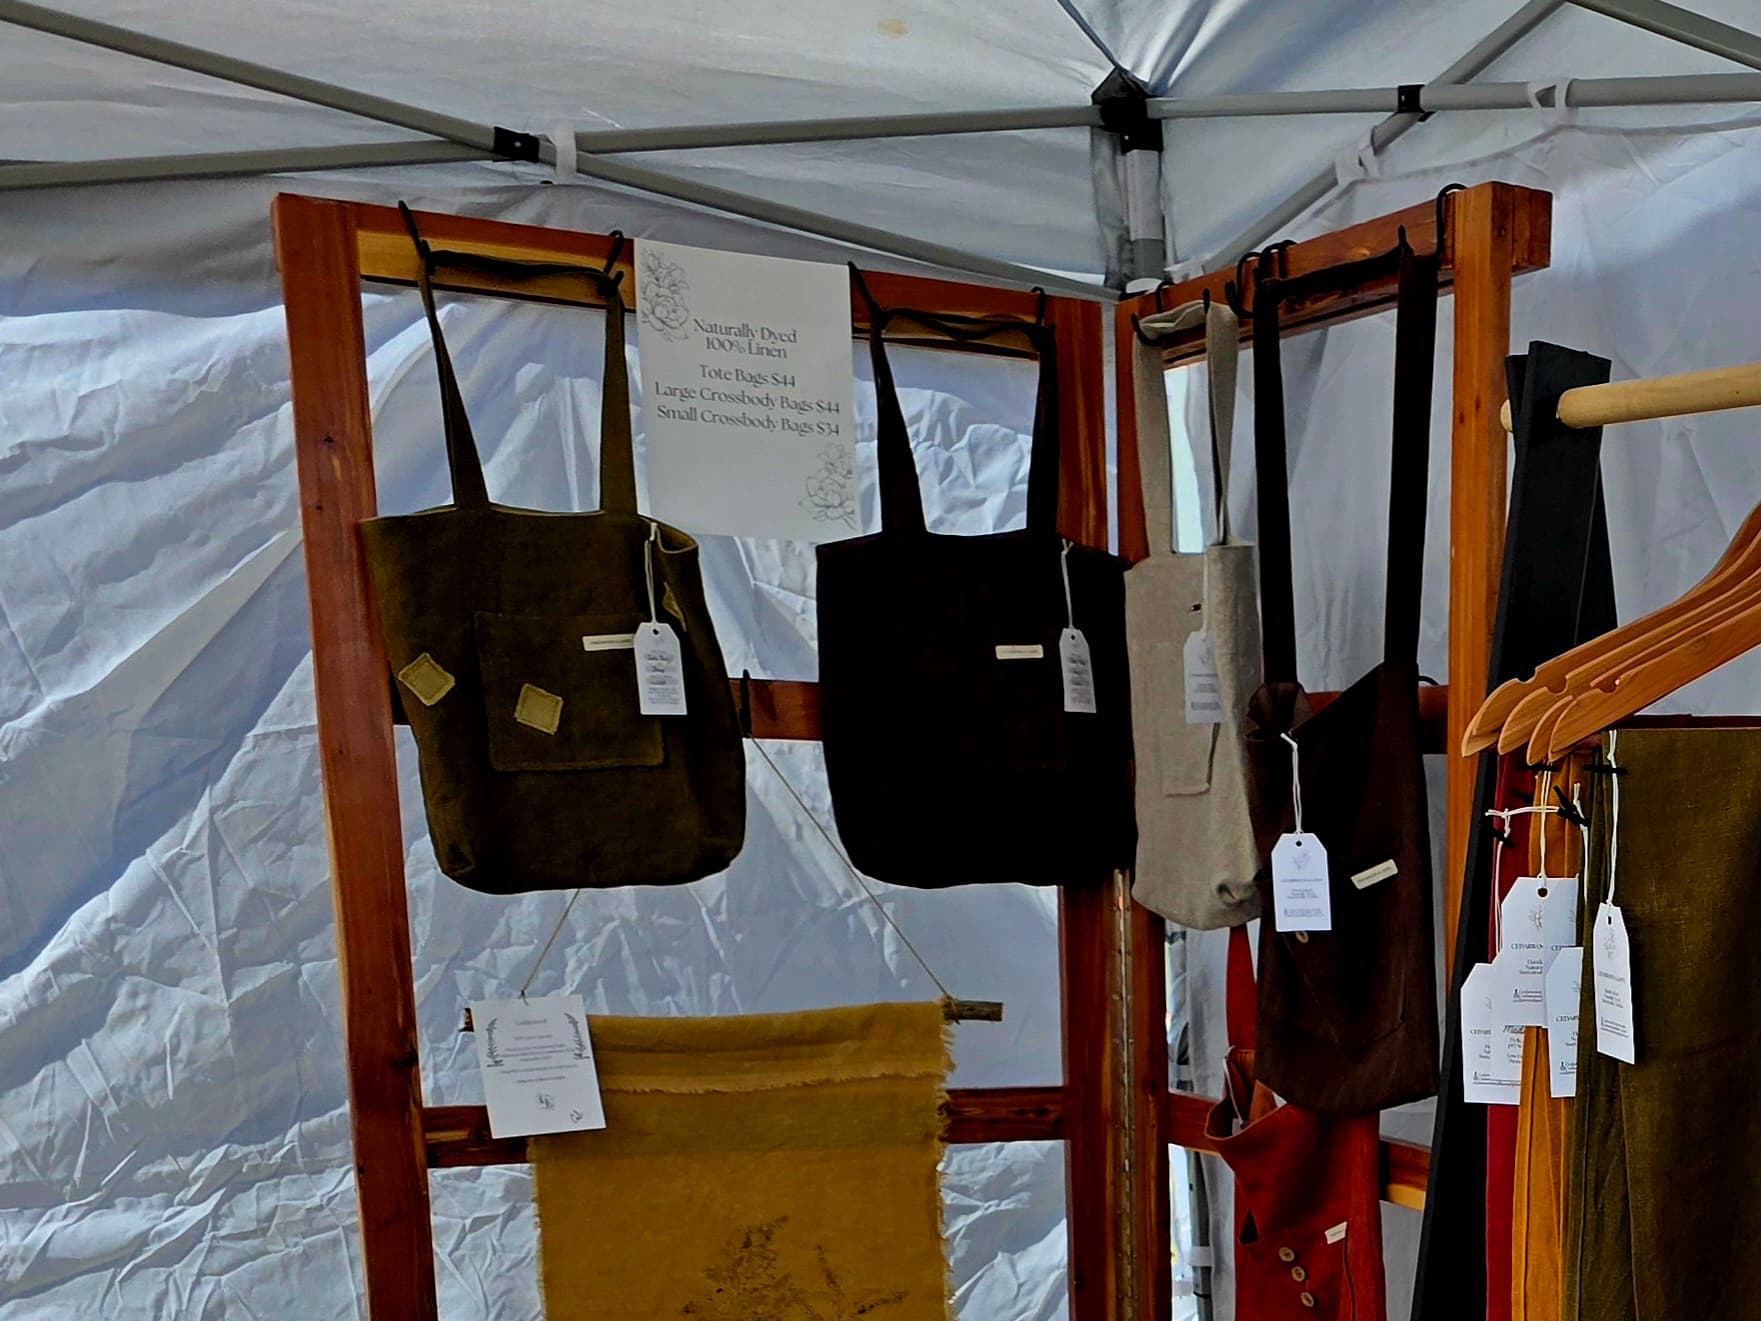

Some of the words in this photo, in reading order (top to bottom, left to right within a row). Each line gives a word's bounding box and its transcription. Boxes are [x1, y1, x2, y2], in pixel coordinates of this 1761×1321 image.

[693, 319, 757, 341] Naturally
[760, 326, 797, 344] Dyed
[706, 337, 745, 354] 100%
[747, 340, 787, 359] Linen
[699, 364, 733, 382] Tote
[735, 369, 768, 387] Bags
[771, 373, 796, 387] $44
[655, 382, 697, 401] Large
[700, 387, 777, 410] Crossbody
[780, 396, 814, 414] Bags
[816, 400, 840, 414] $44
[657, 405, 697, 422] Small
[701, 410, 779, 431] Crossbody
[781, 417, 815, 436] Bags
[817, 421, 840, 436] $34
